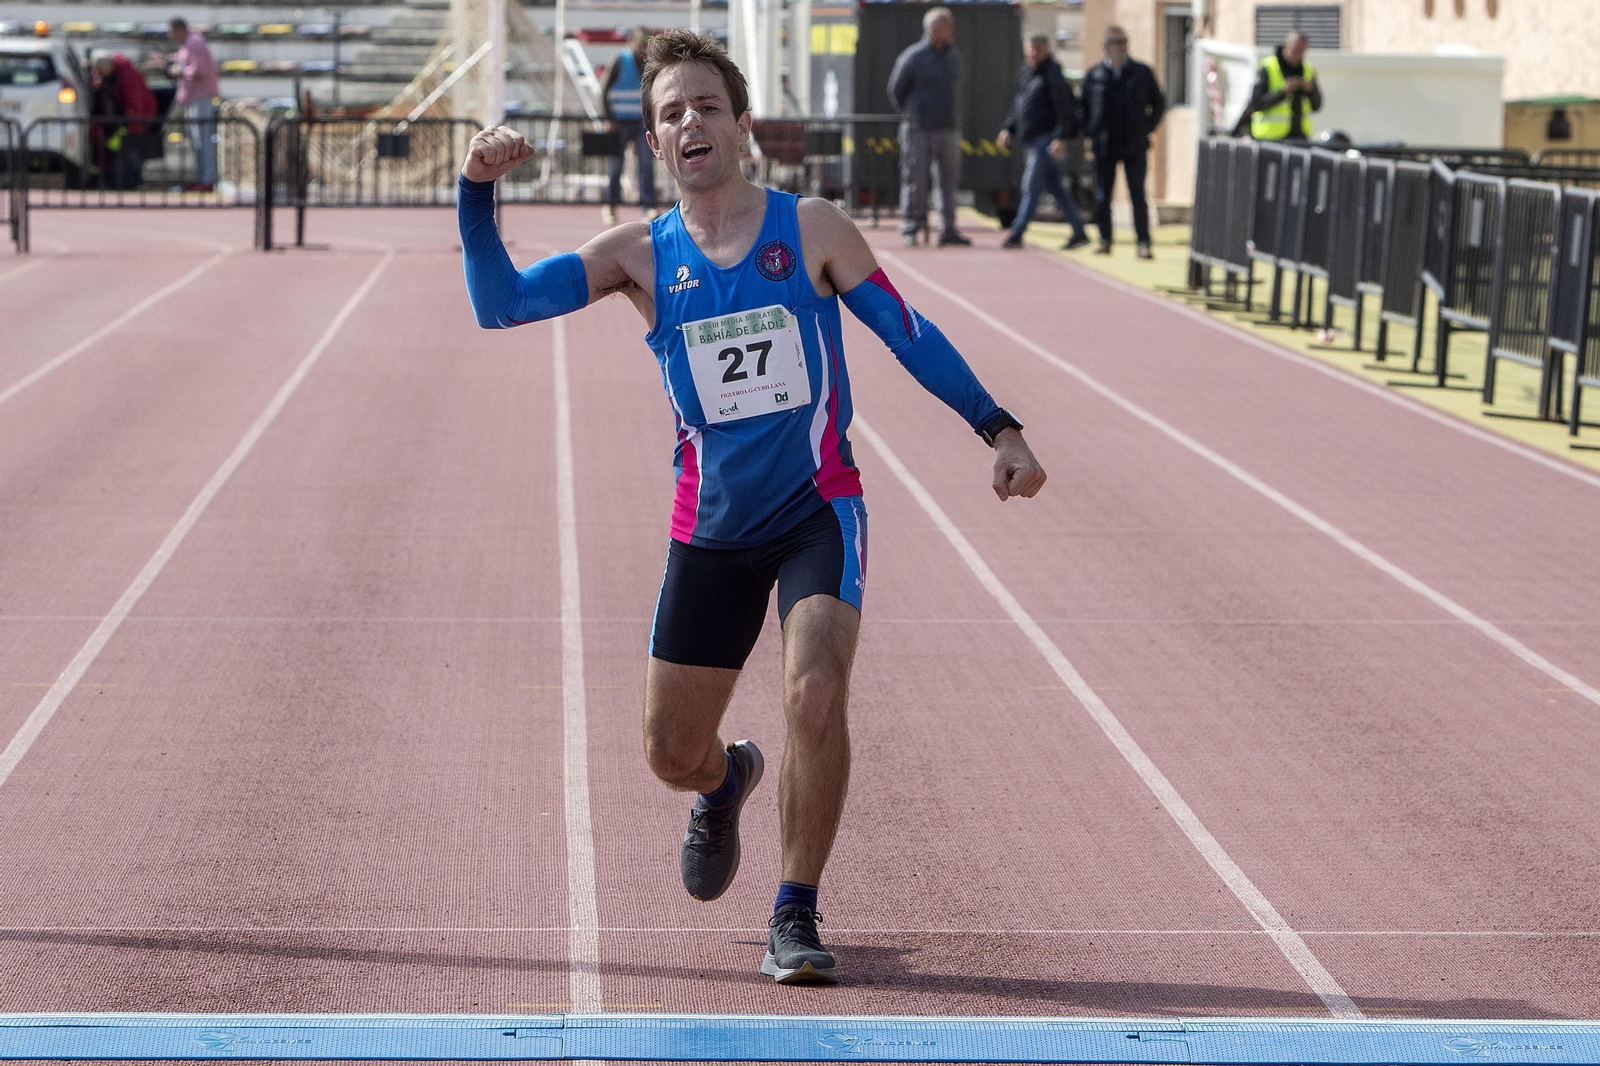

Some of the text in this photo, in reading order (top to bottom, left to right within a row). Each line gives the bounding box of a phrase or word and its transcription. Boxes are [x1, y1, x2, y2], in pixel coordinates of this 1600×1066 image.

[668, 279, 700, 294] VIATOR
[720, 317, 744, 328] MEDIA
[699, 317, 785, 344] BAHÍA DE CÁDIZ
[718, 340, 773, 384] 27
[720, 390, 748, 399] FIGUEROA
